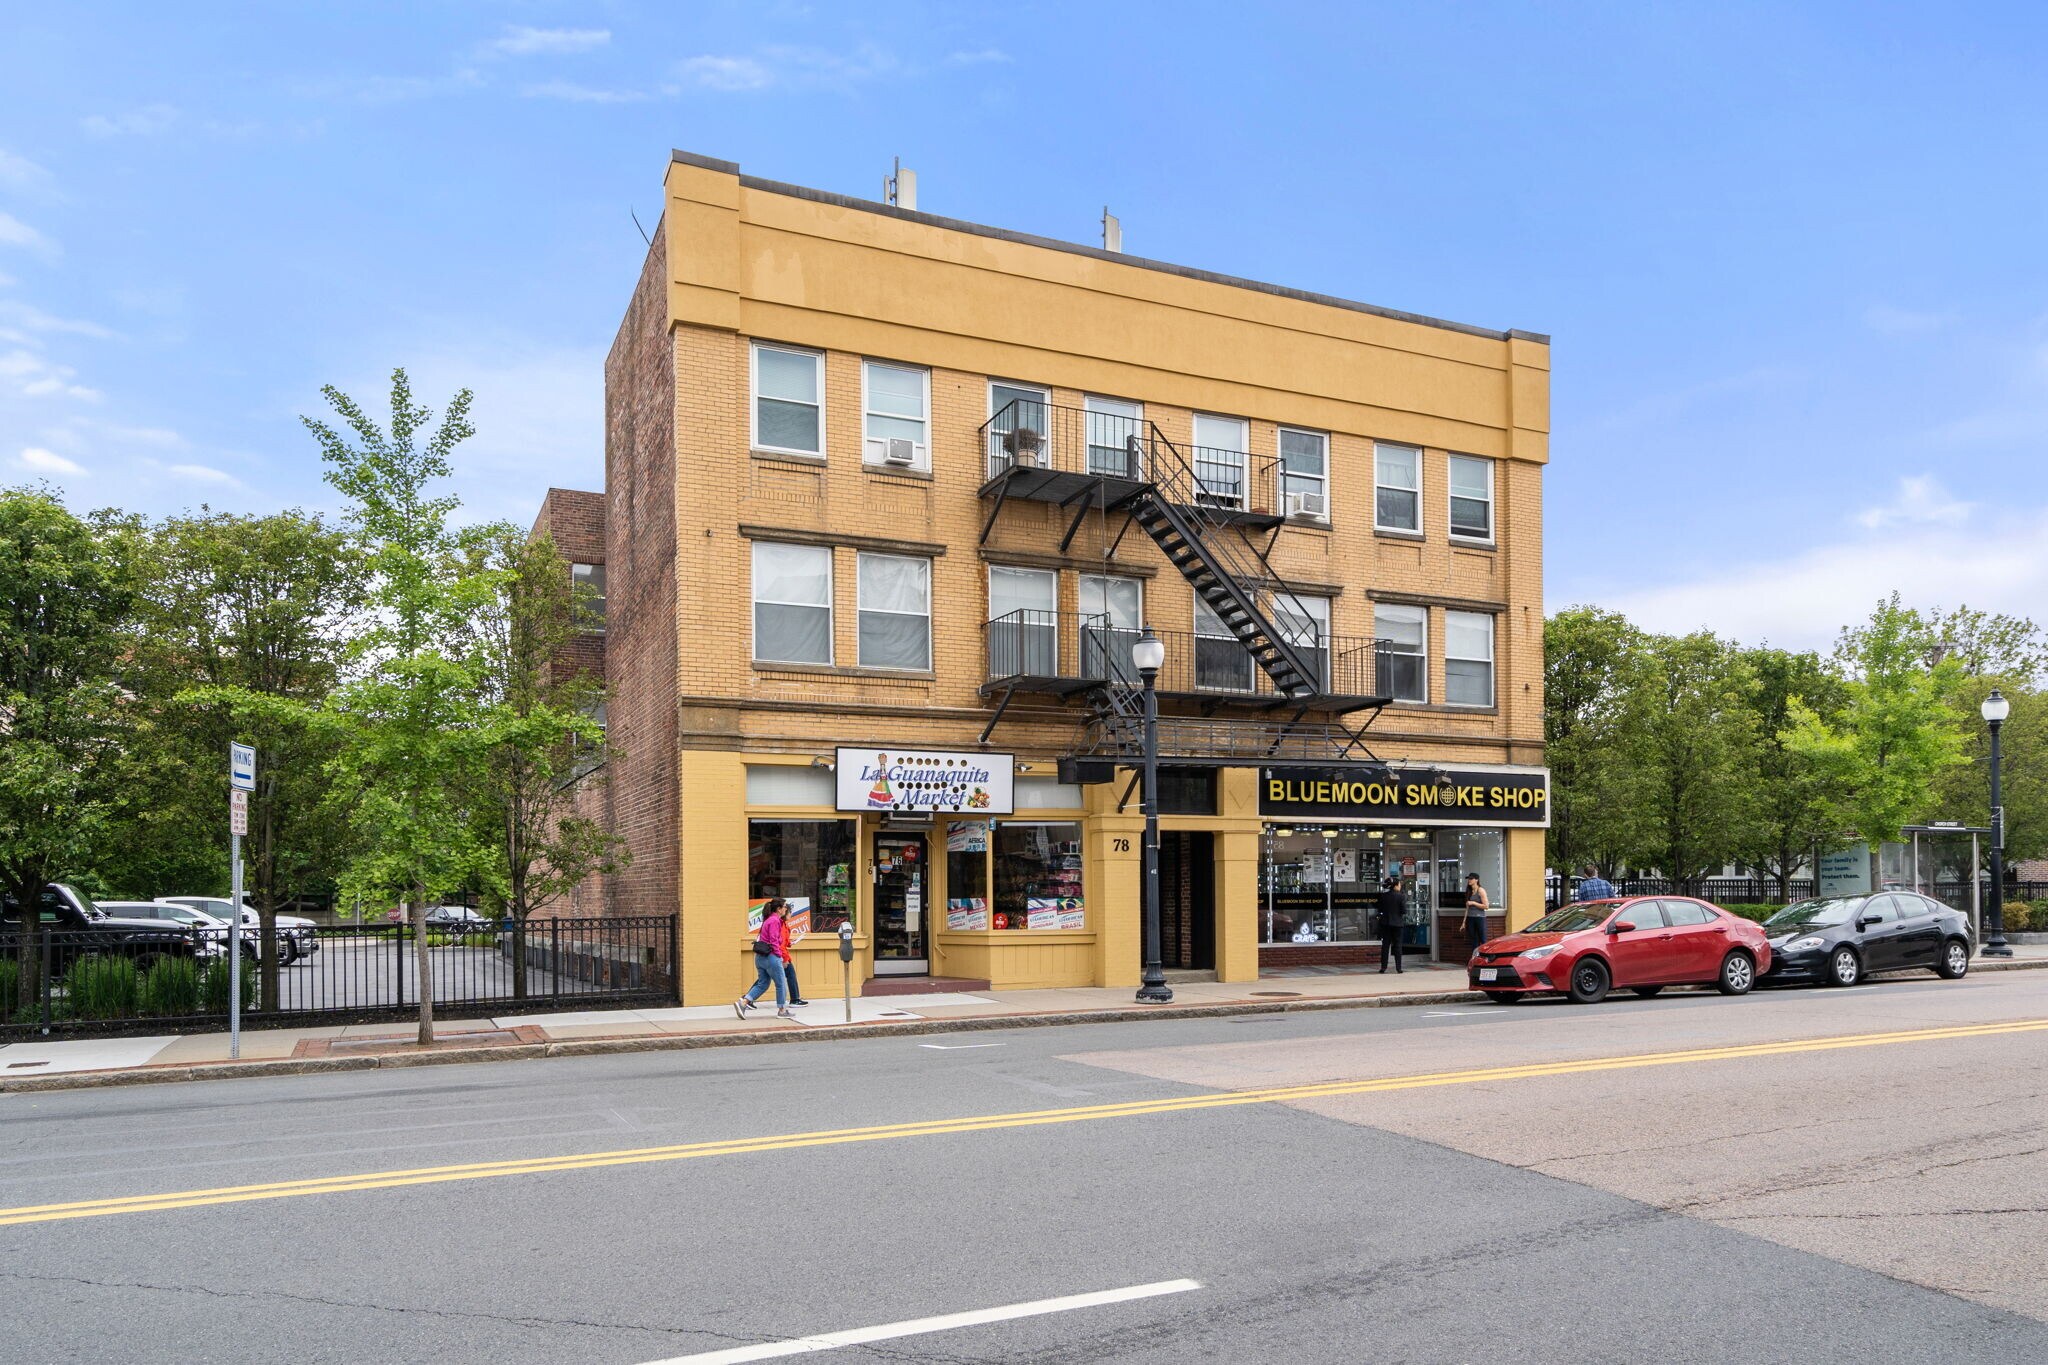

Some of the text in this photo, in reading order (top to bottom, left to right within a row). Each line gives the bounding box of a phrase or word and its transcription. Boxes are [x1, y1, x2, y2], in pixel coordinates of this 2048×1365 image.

[233, 749, 252, 767] PARKING
[860, 765, 989, 787] La Guanaquita
[900, 789, 967, 806] Market
[1270, 780, 1546, 808] BLUEMOON SMOKE SHOP
[1113, 839, 1130, 852] 78
[892, 856, 903, 865] 76
